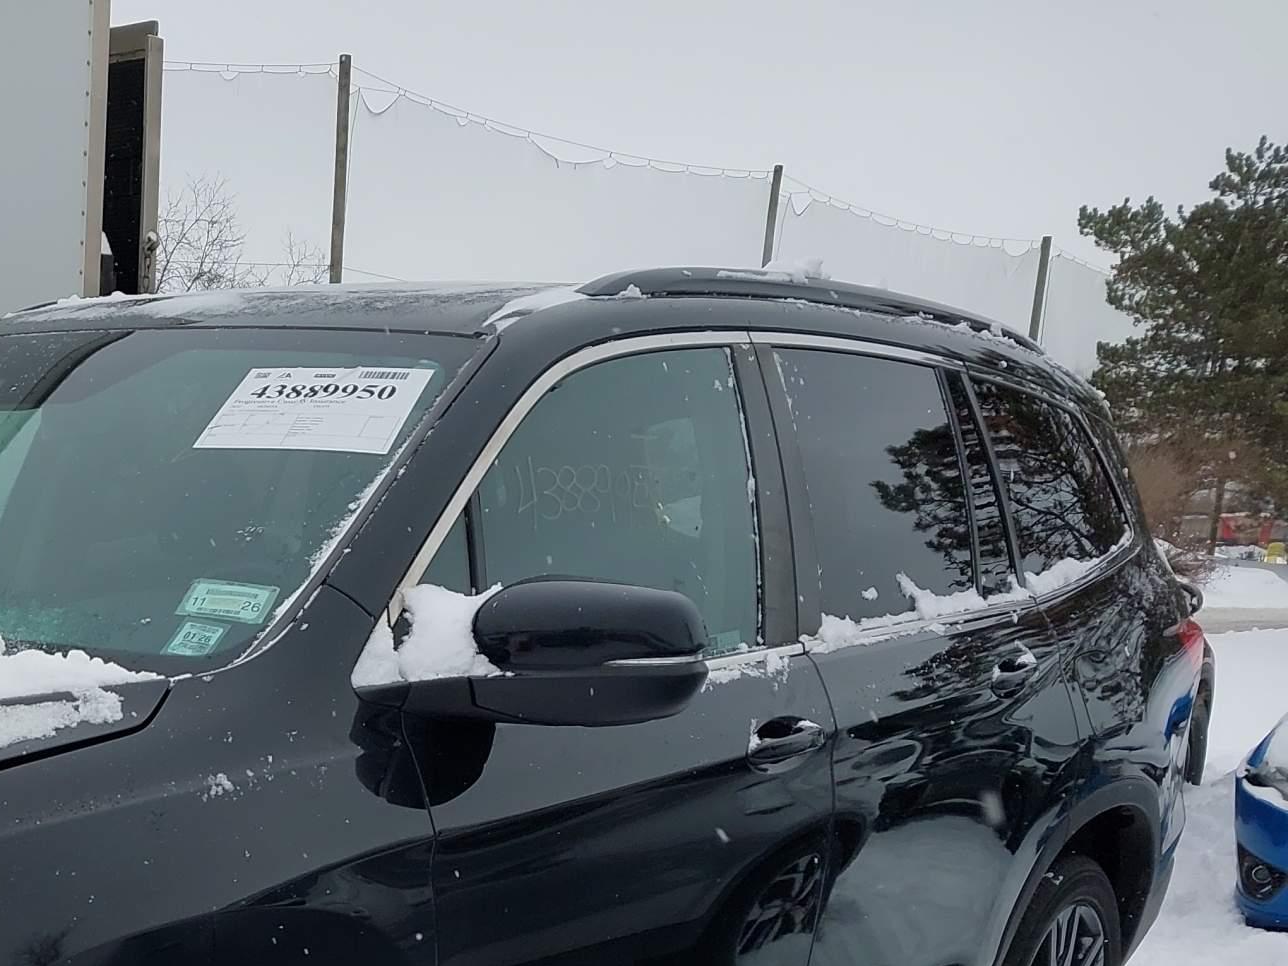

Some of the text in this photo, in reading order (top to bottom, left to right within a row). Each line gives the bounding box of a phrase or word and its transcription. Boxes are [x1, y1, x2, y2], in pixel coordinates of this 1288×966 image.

[250, 383, 397, 401] 43889950
[192, 597, 207, 607] 11
[240, 600, 262, 613] 26
